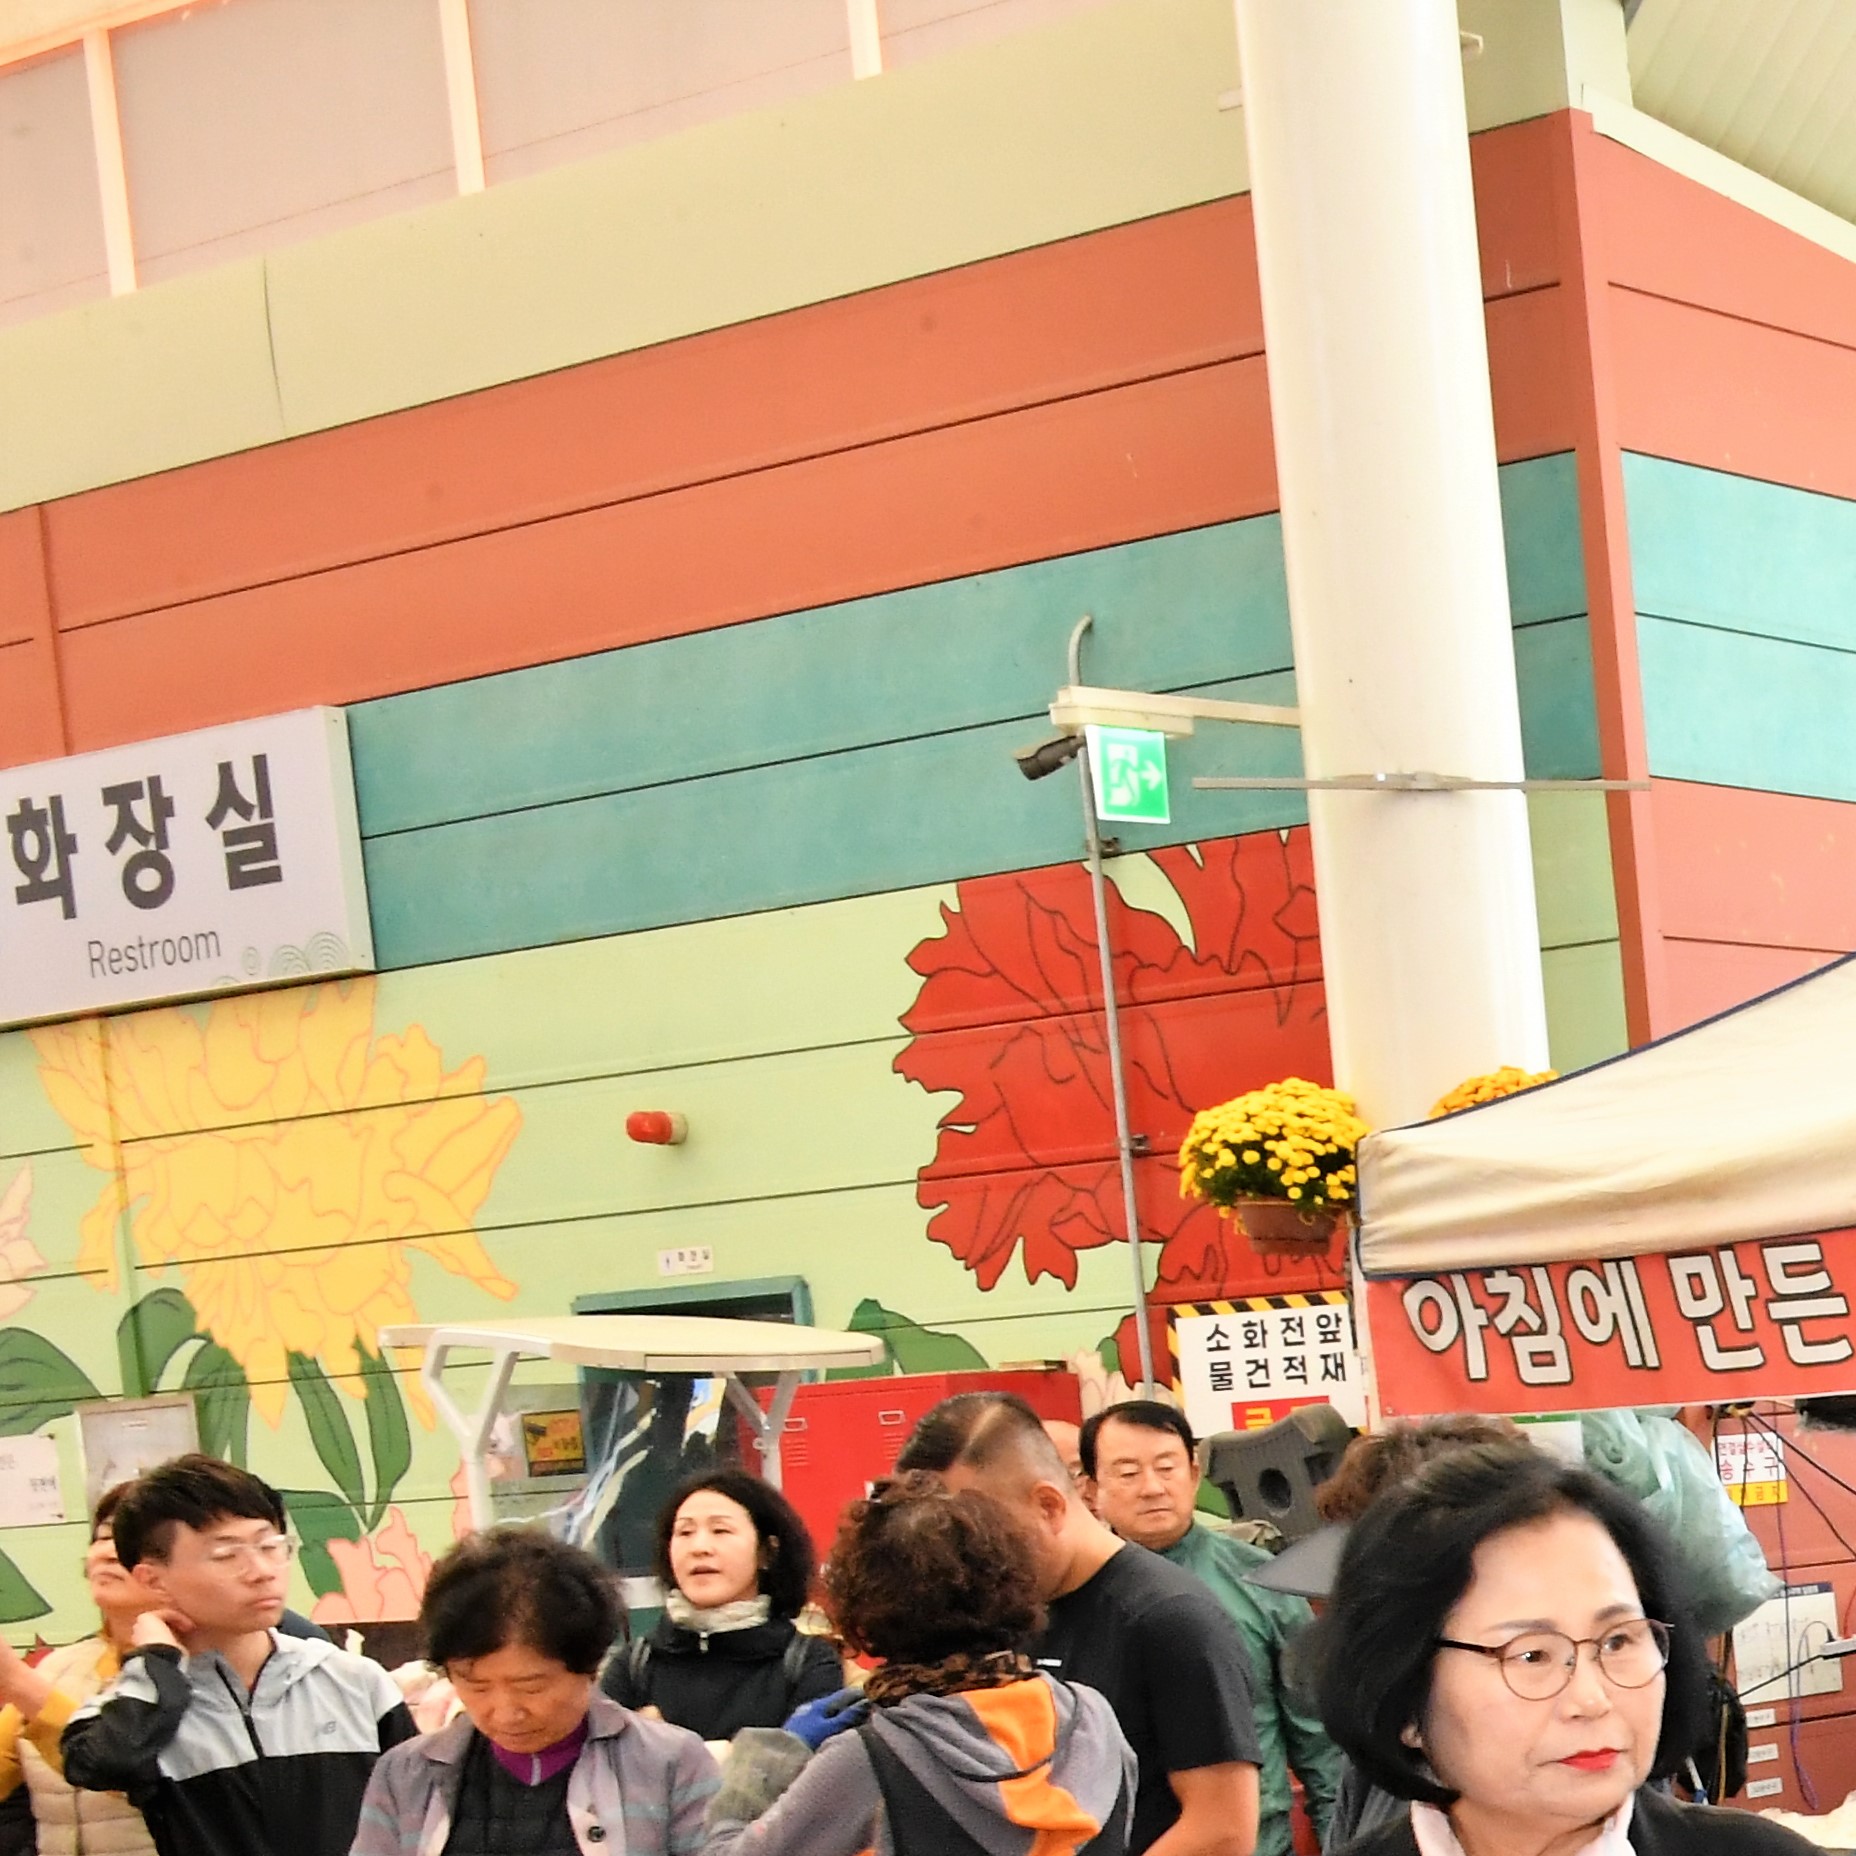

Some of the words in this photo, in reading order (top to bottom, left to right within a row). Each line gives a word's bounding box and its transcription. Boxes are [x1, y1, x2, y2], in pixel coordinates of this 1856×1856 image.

[5, 753, 283, 920] 화장실
[87, 930, 221, 978] Restroom
[1401, 1257, 1663, 1386] 아침에
[1667, 1240, 1854, 1371] 만든
[1209, 1351, 1347, 1393] 물건적재
